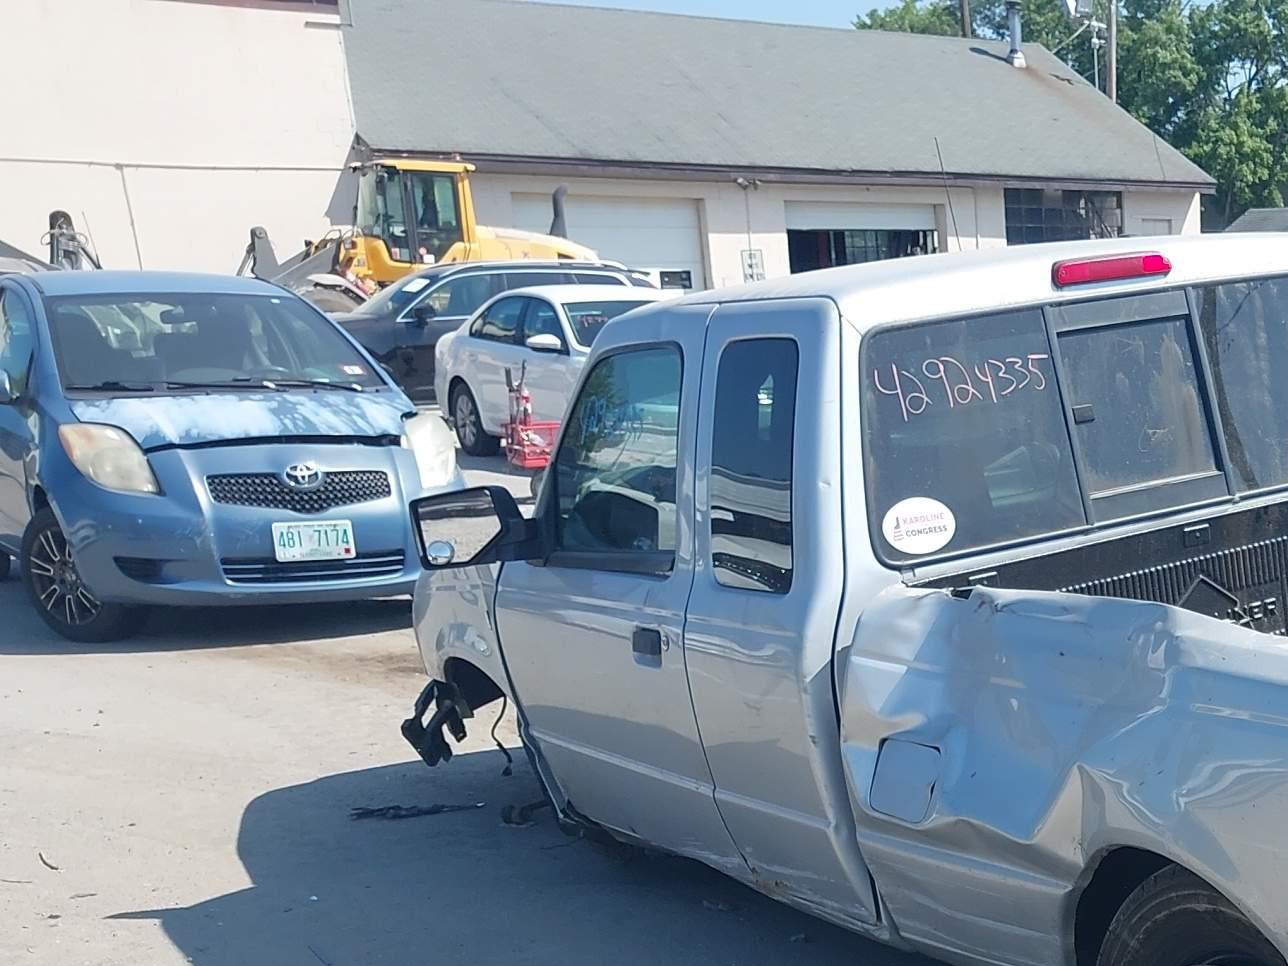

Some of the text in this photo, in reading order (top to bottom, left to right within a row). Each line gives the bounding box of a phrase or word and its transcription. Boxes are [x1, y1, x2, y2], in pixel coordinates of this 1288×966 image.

[875, 354, 1048, 422] 42924335
[902, 512, 945, 525] KAROLINE
[278, 528, 349, 548] 481 7174
[905, 525, 948, 537] CONGRESS
